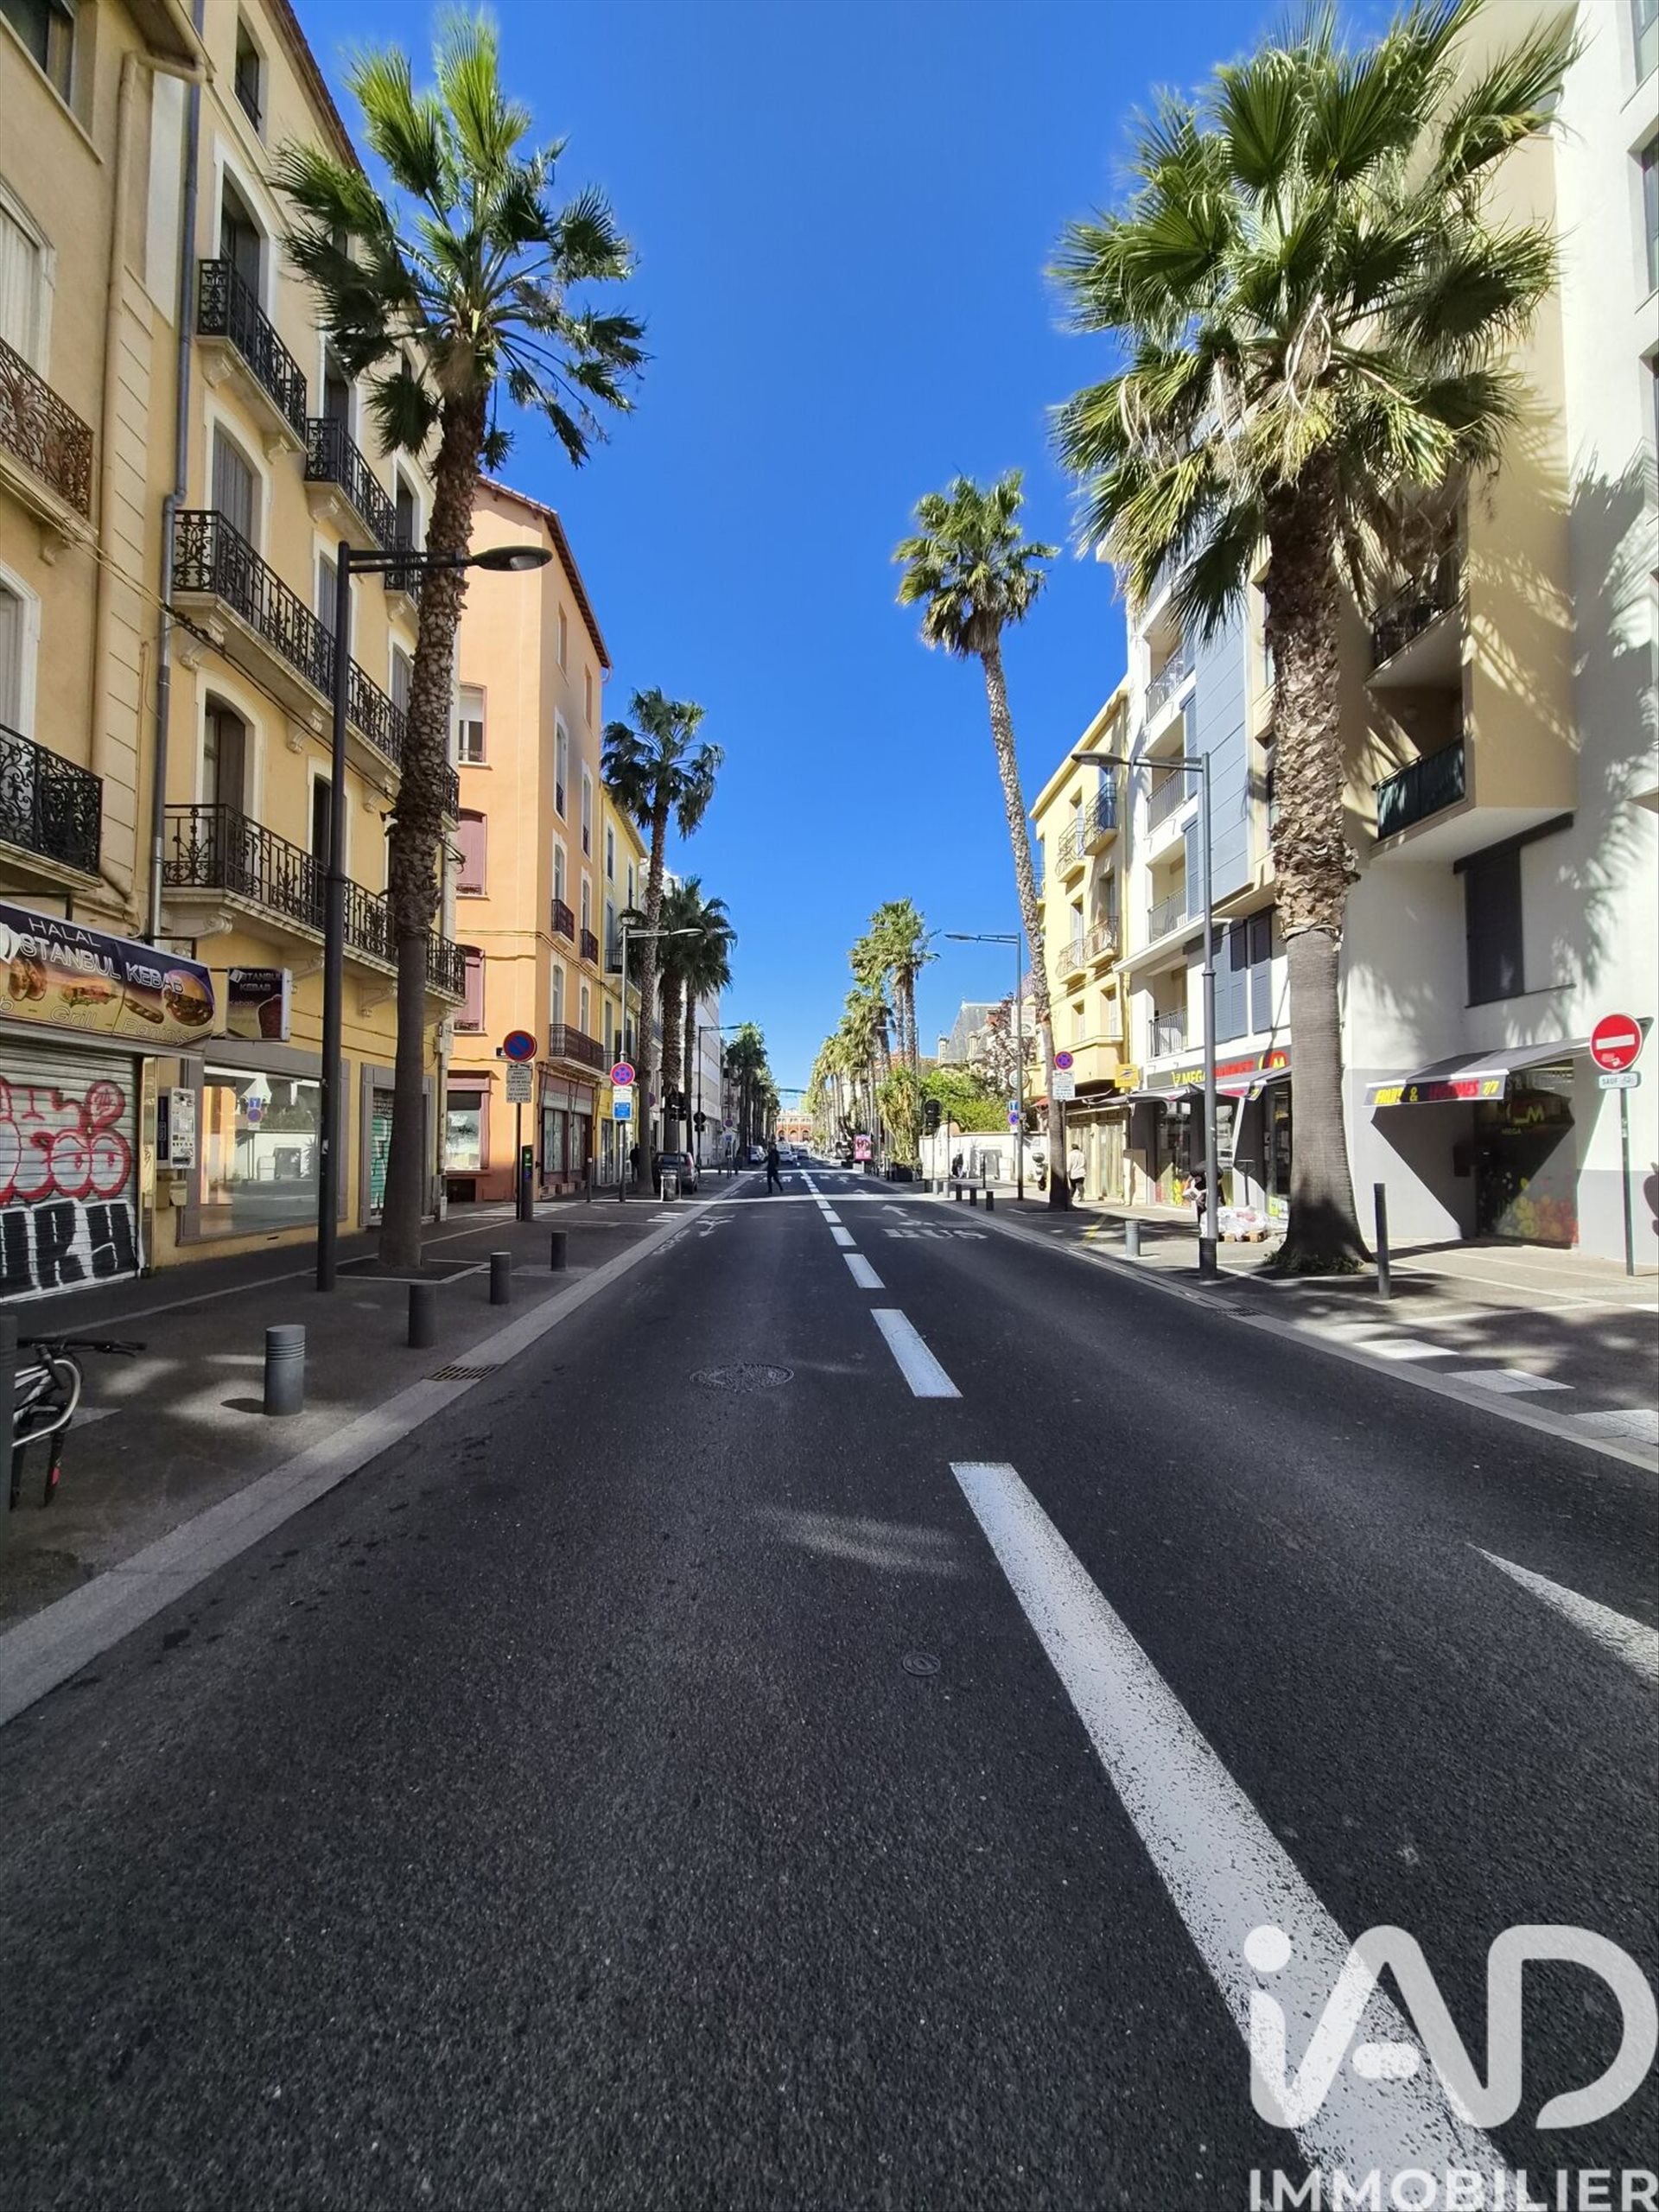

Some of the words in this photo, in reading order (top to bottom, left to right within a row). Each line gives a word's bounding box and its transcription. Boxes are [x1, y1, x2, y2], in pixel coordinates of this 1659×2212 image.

[29, 918, 101, 947] HALAL
[125, 961, 184, 995] KEBAB
[50, 1005, 98, 1028] Grill
[1602, 1077, 1618, 1085] SAUF
[880, 1228, 989, 1239] BUS
